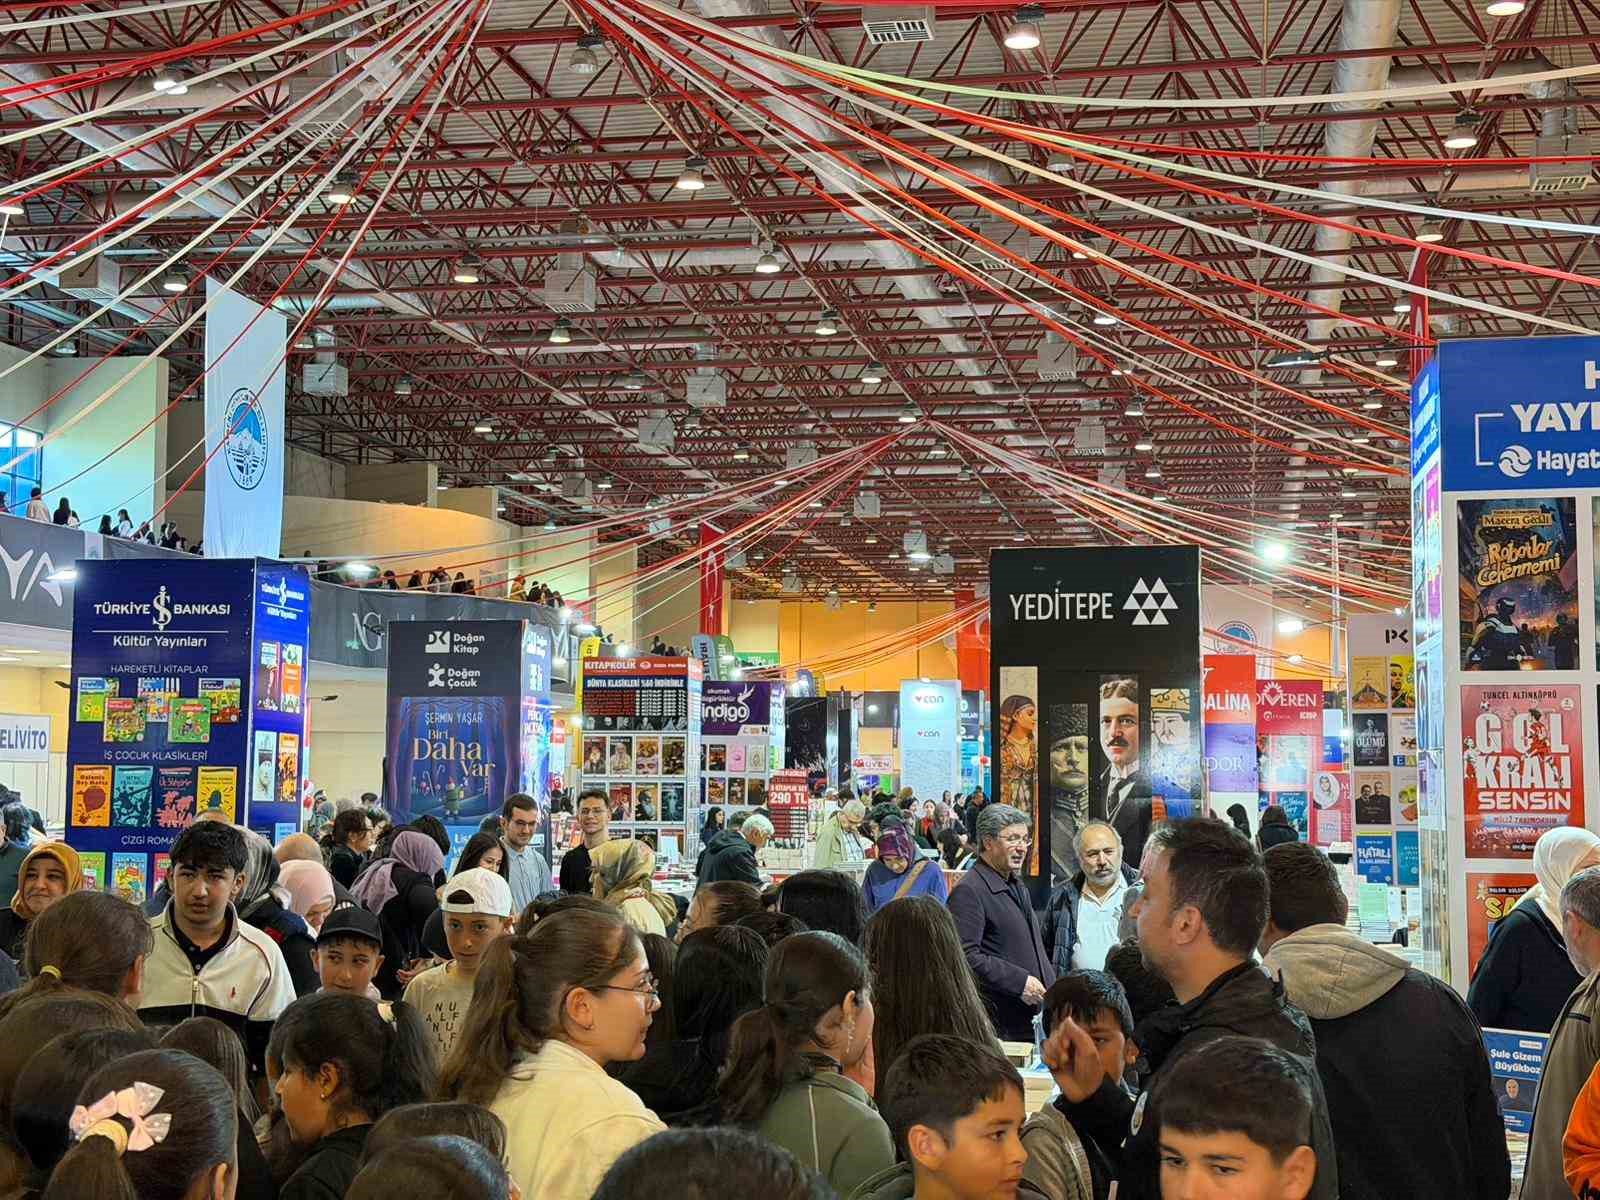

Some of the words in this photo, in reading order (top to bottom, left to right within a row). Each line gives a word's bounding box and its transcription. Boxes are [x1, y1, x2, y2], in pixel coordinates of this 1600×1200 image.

[1537, 449, 1600, 476] Hayat
[1488, 535, 1552, 563] Robotlar
[1477, 553, 1560, 586] Cehennemi
[94, 602, 150, 615] TÜRKİYE
[174, 605, 230, 615] BANKASI
[1009, 588, 1114, 620] YEDİTEPE
[113, 635, 152, 647] Kültür
[155, 635, 207, 648] Yayınları
[454, 633, 485, 644] Doğan
[454, 645, 479, 655] Kitap
[111, 664, 160, 674] HAREKETLİ
[164, 664, 208, 674] KİTAPLAR
[448, 668, 480, 679] Doğan
[448, 678, 478, 689] Çocuk
[1482, 691, 1510, 700] TUNCEL
[1513, 690, 1557, 700] ALTINKÖPRÜ
[425, 712, 454, 725] ŞERMİN
[457, 712, 483, 725] YAŞAR
[702, 703, 749, 723] indigo
[413, 736, 481, 760] Daha
[153, 750, 208, 761] KLASİKLERİ
[460, 760, 496, 777] Var
[770, 792, 791, 804] 290
[793, 792, 808, 804] TL
[121, 834, 145, 846] ÇİZGİ
[147, 835, 176, 845] ROMA
[1490, 1049, 1511, 1060] Şule
[1512, 1051, 1541, 1062] Gizem
[1495, 1061, 1541, 1074] Büyükboz
